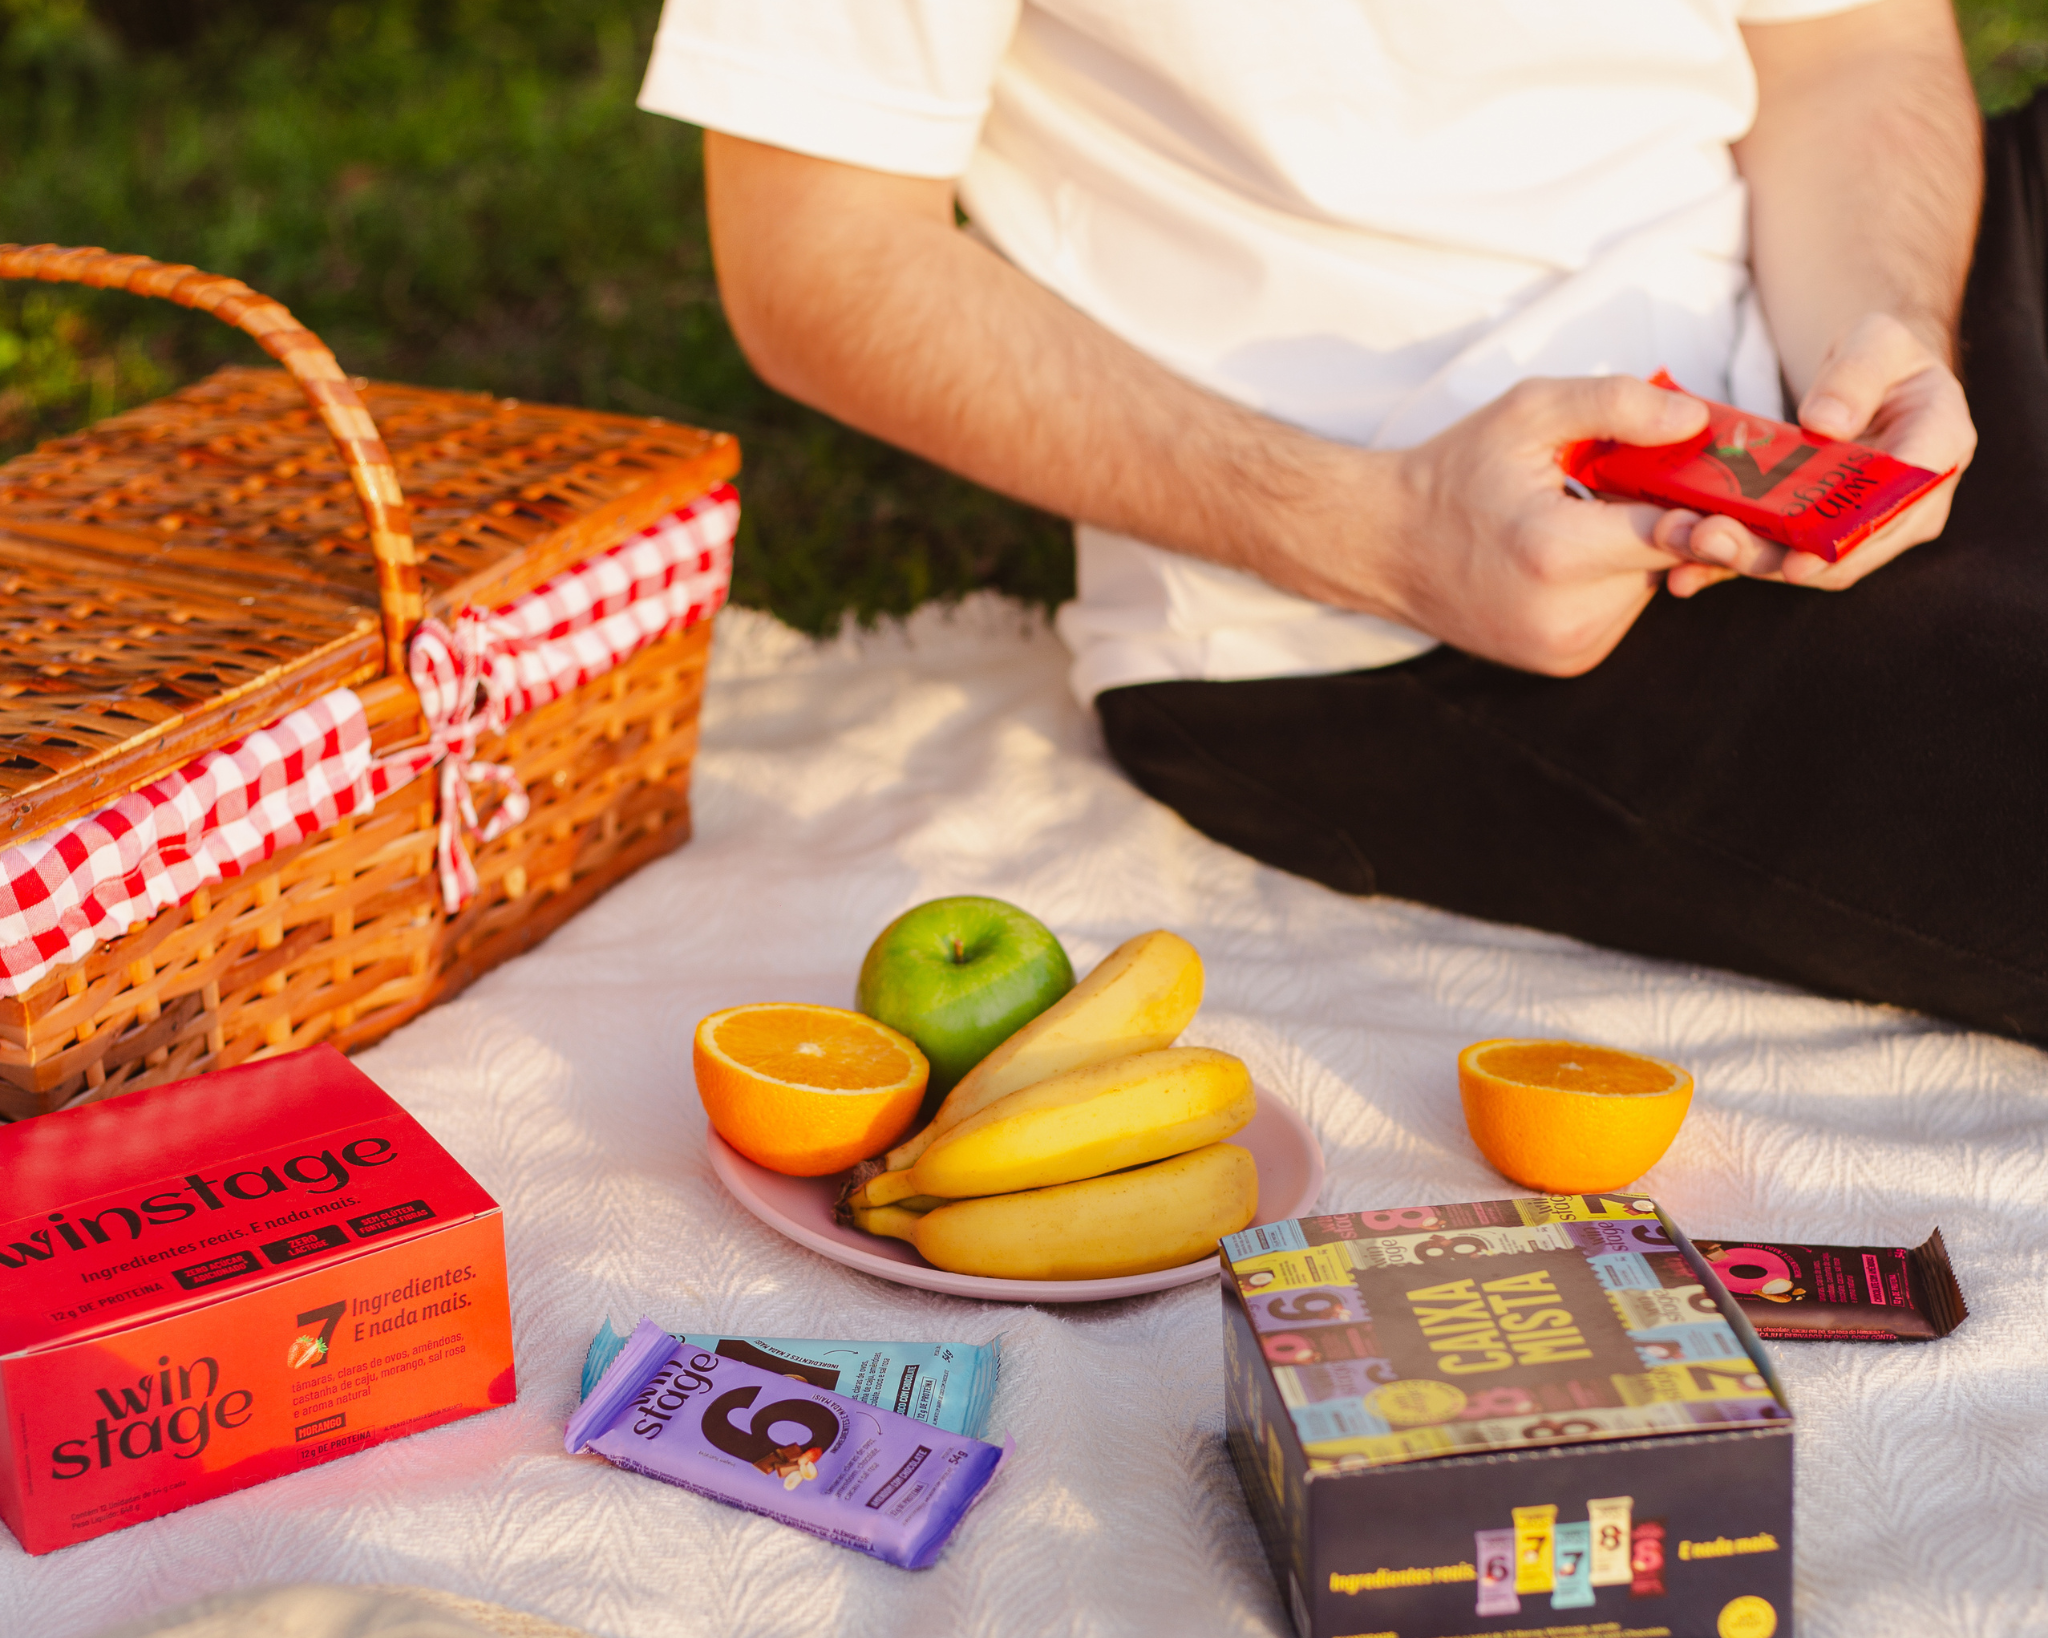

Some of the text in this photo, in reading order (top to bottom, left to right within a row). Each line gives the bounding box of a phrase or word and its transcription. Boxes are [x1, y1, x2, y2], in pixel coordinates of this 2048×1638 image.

[0, 1138, 398, 1269] winstage
[360, 1204, 416, 1226] SEM GLÚTEN
[358, 1209, 429, 1235] FONTE DE FIBRAS
[1599, 1221, 1629, 1252] stage
[80, 1194, 363, 1284] Ingredientes reais. E nada mais.
[287, 1234, 318, 1248] ZERO
[287, 1239, 329, 1257] LACTOSE
[184, 1265, 209, 1278] ZERO
[50, 1281, 166, 1323] 12 g DE PROTEÍNA
[352, 1264, 478, 1318] Ingredientes.
[354, 1291, 473, 1343] E nada mais.
[1405, 1277, 1514, 1375] CAIXA
[1481, 1269, 1594, 1366] MISTA
[296, 1299, 348, 1370] 7
[1758, 1331, 1778, 1339] CAJU
[1783, 1332, 1823, 1340] DERIVADOS
[291, 1332, 466, 1394] tâmaras, claras de ovos, amêndoas,
[769, 1346, 786, 1357] NADA
[789, 1354, 840, 1370] INGREDIENTES
[94, 1354, 221, 1421] win
[292, 1344, 467, 1406] castanha de caju, morango, sal rosa
[900, 1365, 916, 1402] COM CHOCOLATE
[293, 1386, 372, 1419] e aroma natural
[633, 1352, 720, 1441] stage
[921, 1380, 933, 1403] PROTEÍNA
[830, 1401, 846, 1416] NADA
[51, 1388, 255, 1480] stage
[298, 1415, 342, 1439] MORANGO
[701, 1385, 840, 1466] 6
[300, 1429, 372, 1460] 12 g DE PROTEÍNA
[900, 1450, 926, 1478] CHOCOLATE
[142, 1491, 152, 1499] de
[169, 1480, 187, 1490] cada
[1526, 1535, 1547, 1560] 7
[1600, 1525, 1622, 1551] 8
[1678, 1540, 1693, 1562] E
[1692, 1535, 1735, 1559] nada
[1487, 1555, 1509, 1582] 6
[1562, 1551, 1584, 1576] 7
[1329, 1567, 1433, 1596] Ingredientes
